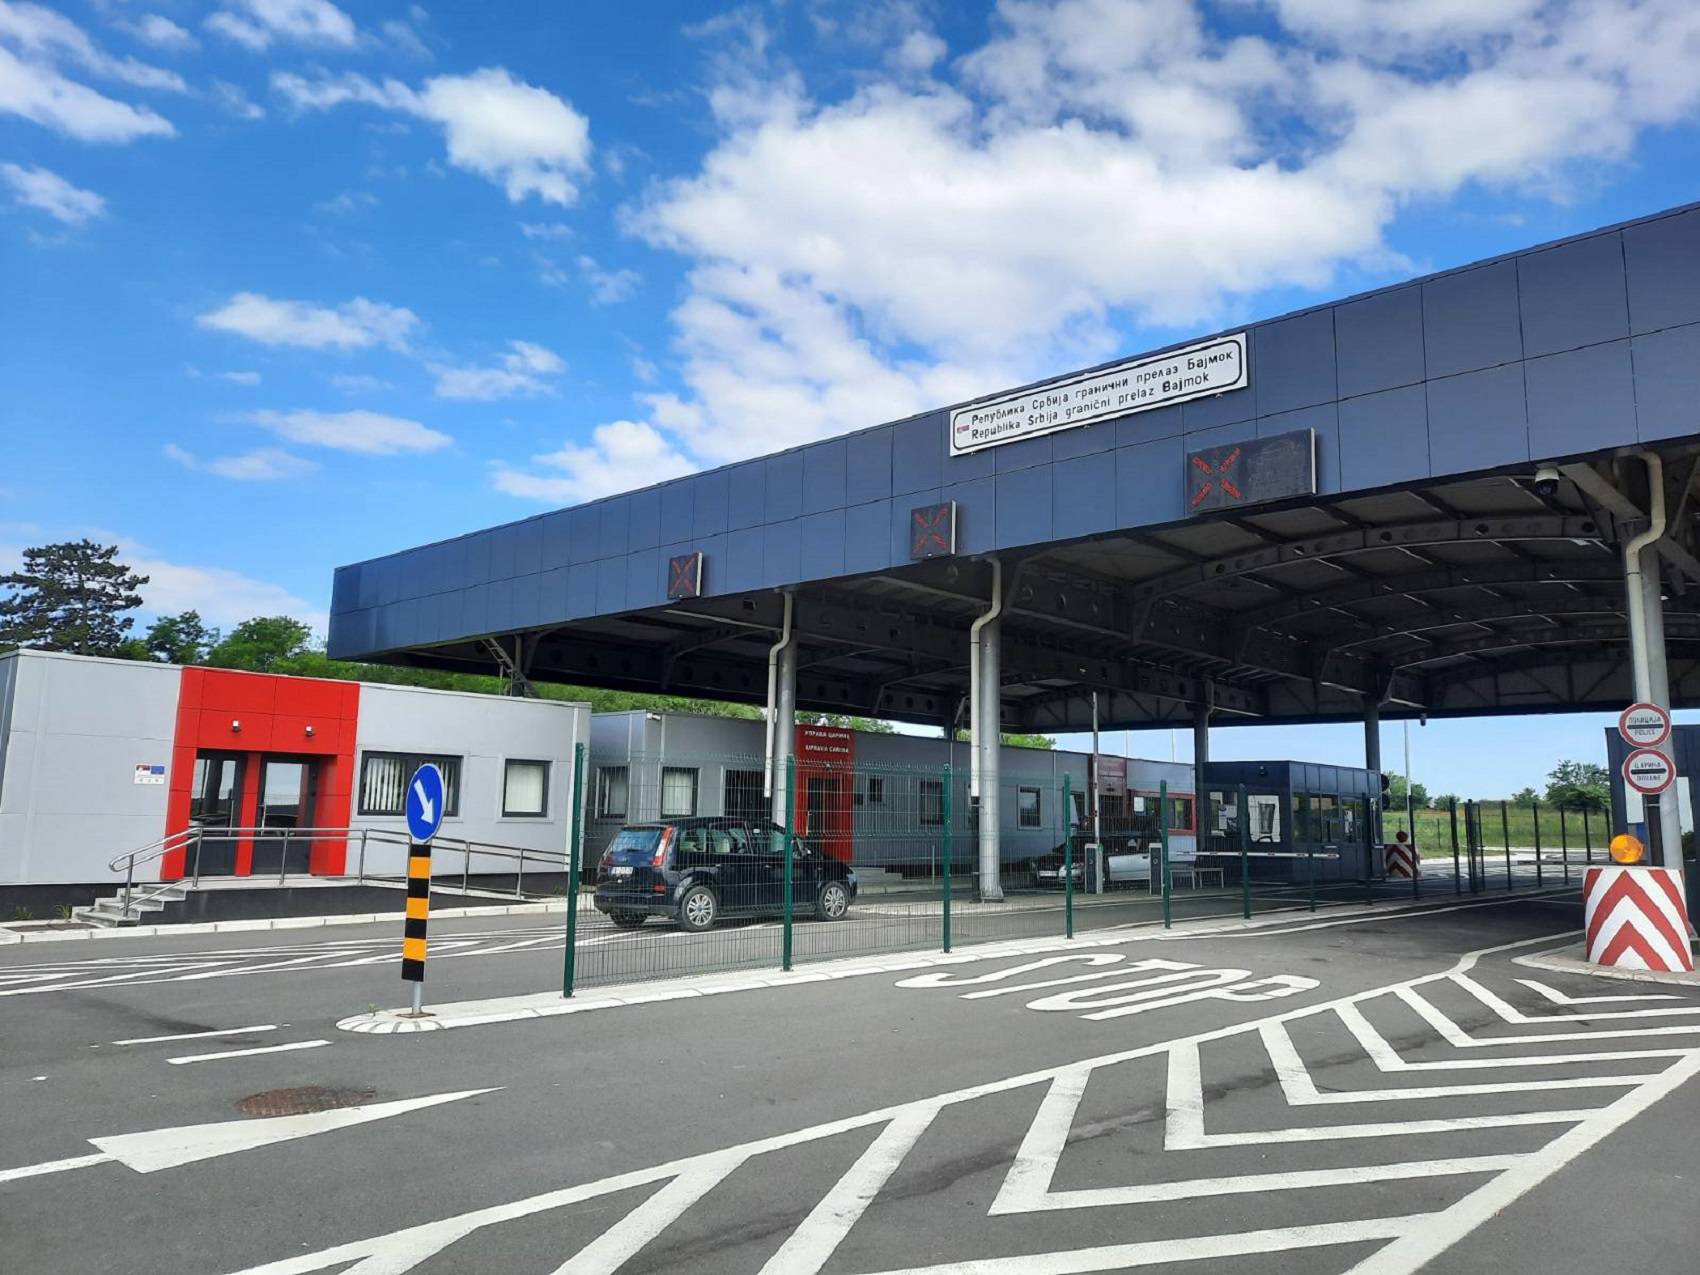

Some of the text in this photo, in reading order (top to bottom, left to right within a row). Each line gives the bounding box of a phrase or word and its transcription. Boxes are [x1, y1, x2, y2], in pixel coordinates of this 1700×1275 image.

[972, 350, 1233, 425] Република Србија гранични прелаз Бајмок
[972, 372, 1209, 440] Republika Srbija granični prelaz Bajmok
[895, 954, 1320, 1020] STOP
